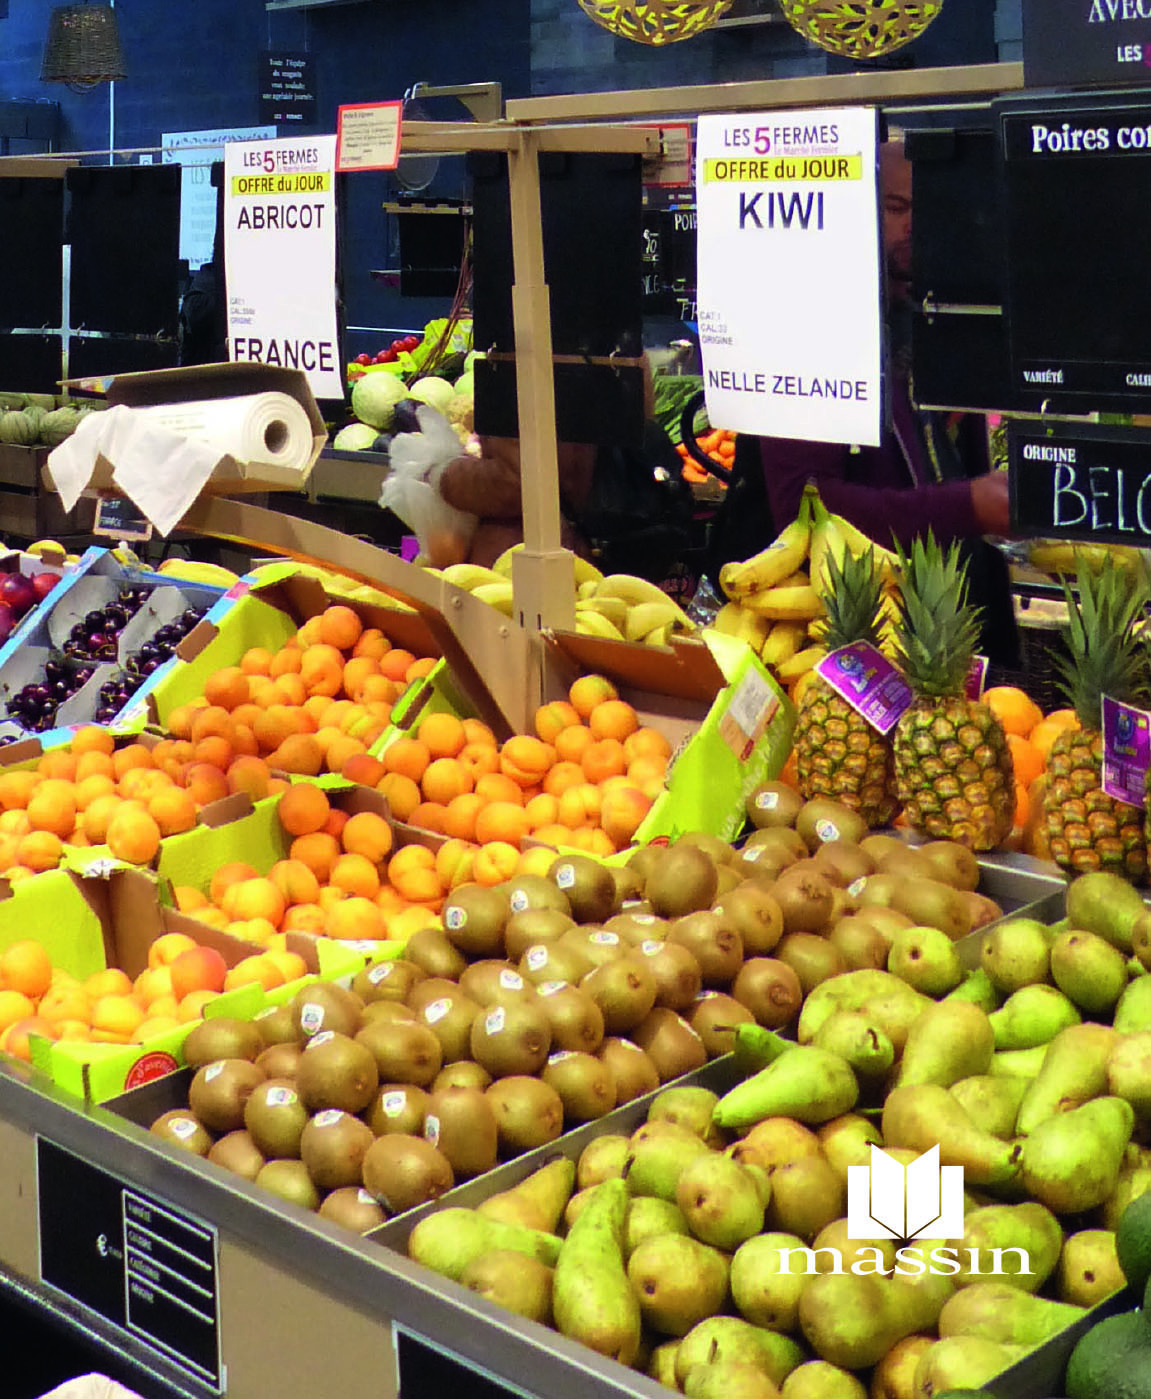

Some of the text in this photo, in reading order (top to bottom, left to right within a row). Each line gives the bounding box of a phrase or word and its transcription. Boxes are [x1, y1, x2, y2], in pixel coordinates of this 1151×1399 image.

[1117, 45, 1142, 62] LES
[724, 124, 839, 155] LES 5 FERMES
[1032, 123, 1110, 153] Poires
[243, 152, 262, 167] LES
[263, 150, 276, 173] 5
[276, 148, 319, 165] FERMES
[715, 159, 850, 180] OFFRE du JOUR
[238, 175, 324, 193] OFFRE du JOUR
[237, 204, 325, 230] ABRICOT
[739, 191, 824, 230] KIWI
[234, 338, 335, 372] FRANCE
[708, 369, 869, 401] NELLE ZELANDE
[1022, 369, 1064, 384] VARIÉTÉ
[1022, 444, 1077, 463] ORIGINE
